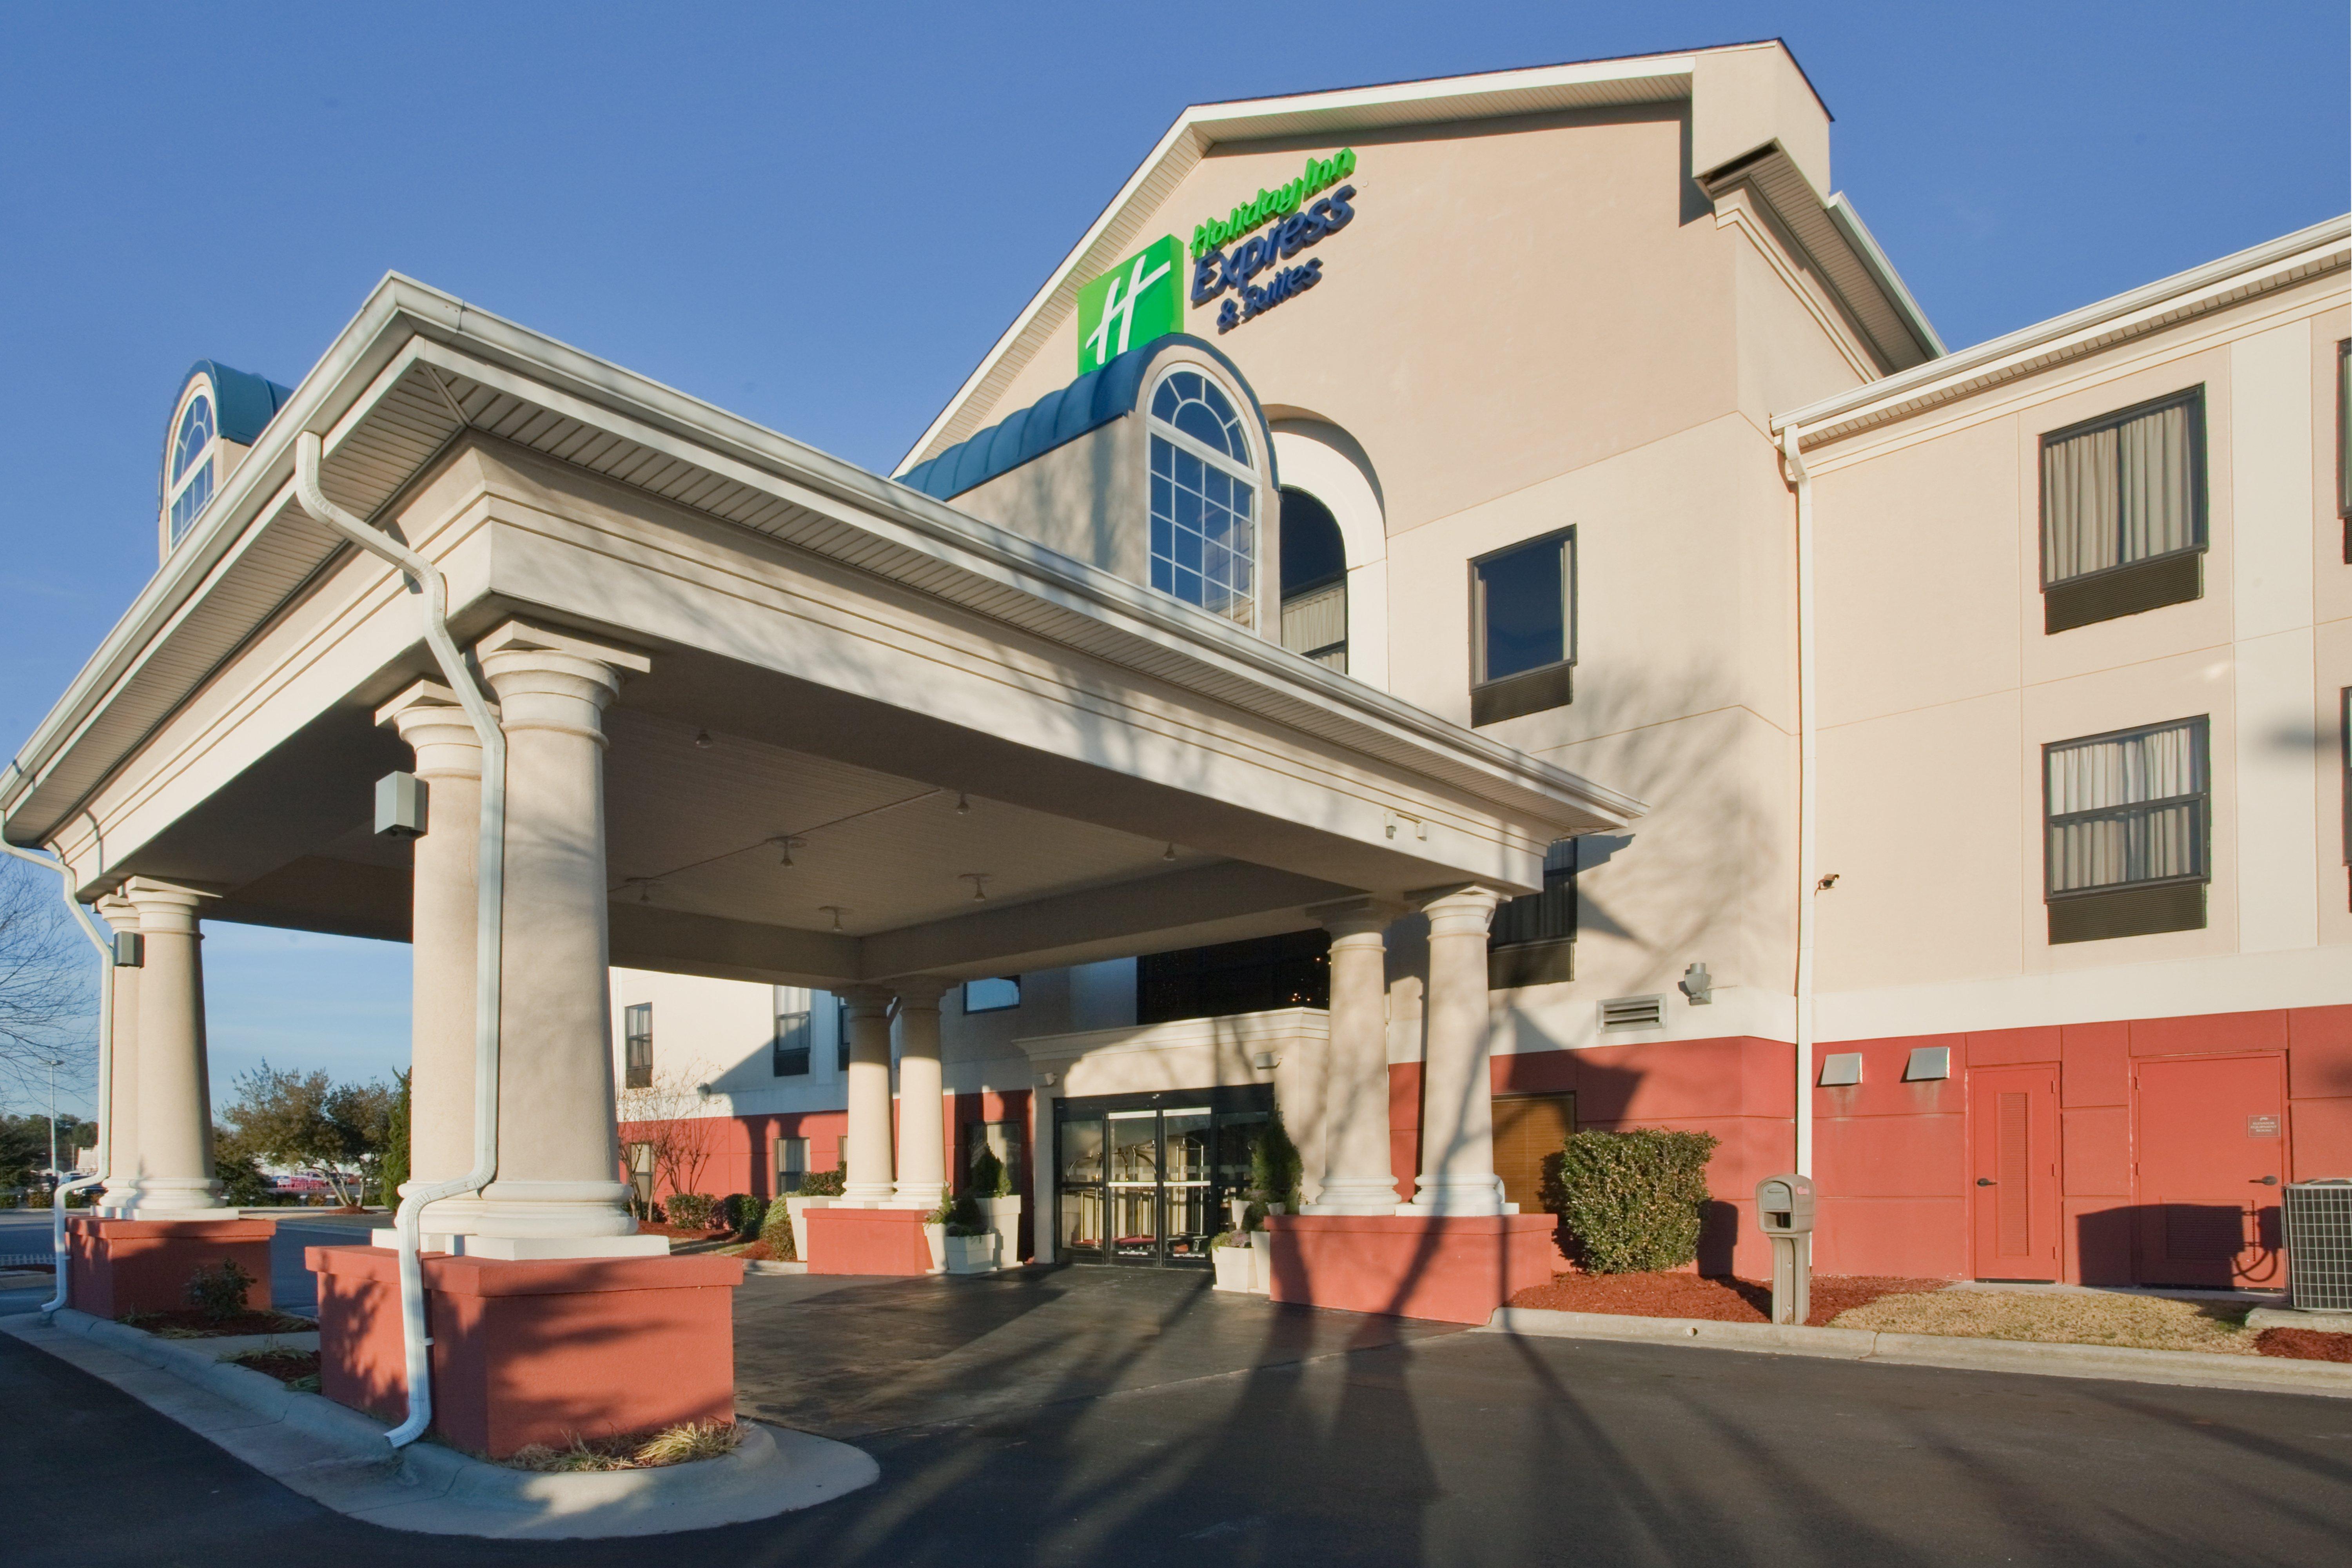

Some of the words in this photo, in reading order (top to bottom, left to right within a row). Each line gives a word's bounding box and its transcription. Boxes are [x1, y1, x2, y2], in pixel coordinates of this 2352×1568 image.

[1189, 177, 1303, 259] Holiday
[1302, 147, 1357, 202] Inn
[1217, 298, 1240, 335] &
[1240, 257, 1324, 324] Suites
